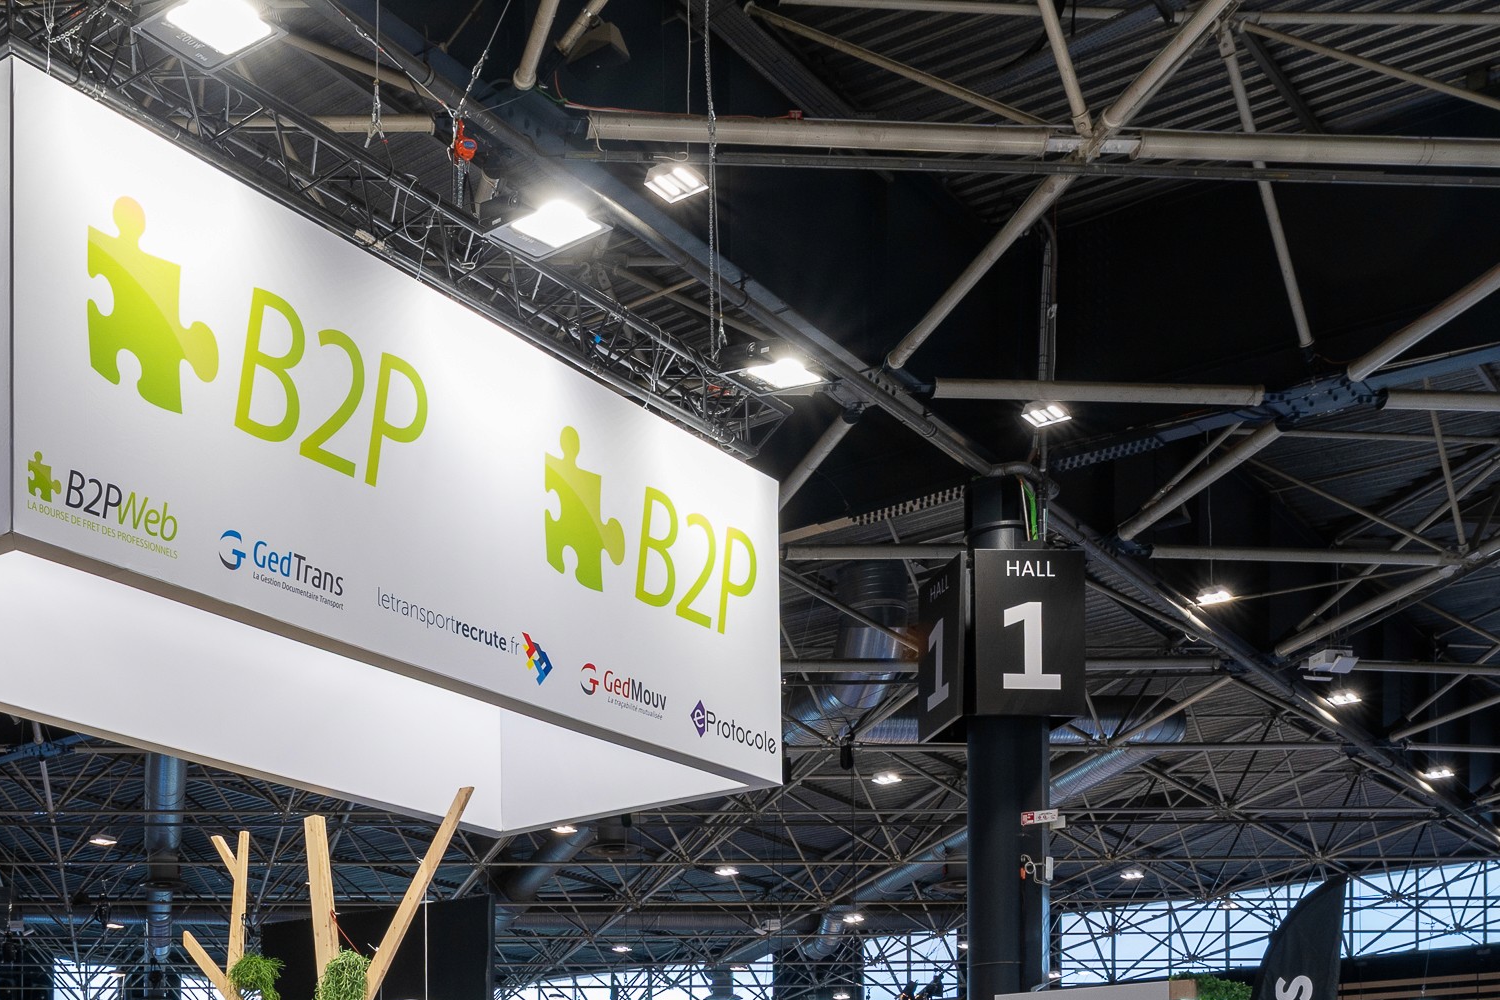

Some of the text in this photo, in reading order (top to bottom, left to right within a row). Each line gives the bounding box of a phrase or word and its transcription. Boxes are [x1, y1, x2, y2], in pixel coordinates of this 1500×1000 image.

[234, 286, 429, 488] B2P
[27, 499, 178, 559] LA BOURSE DE FRET DES PROFESSIONNELS
[65, 469, 178, 541] B2PWeb
[253, 540, 344, 596] GedTrans
[634, 485, 758, 635] B2P
[930, 574, 949, 603] HALL
[1006, 560, 1056, 577] HALL
[252, 571, 344, 610] La Gestion Documentaire Transport
[377, 586, 520, 655] letransportrecrute.fr
[927, 617, 949, 712] 1
[1003, 601, 1061, 690] 1
[603, 670, 667, 711] GedMouv
[607, 696, 663, 721] La traçabilité mutualisée
